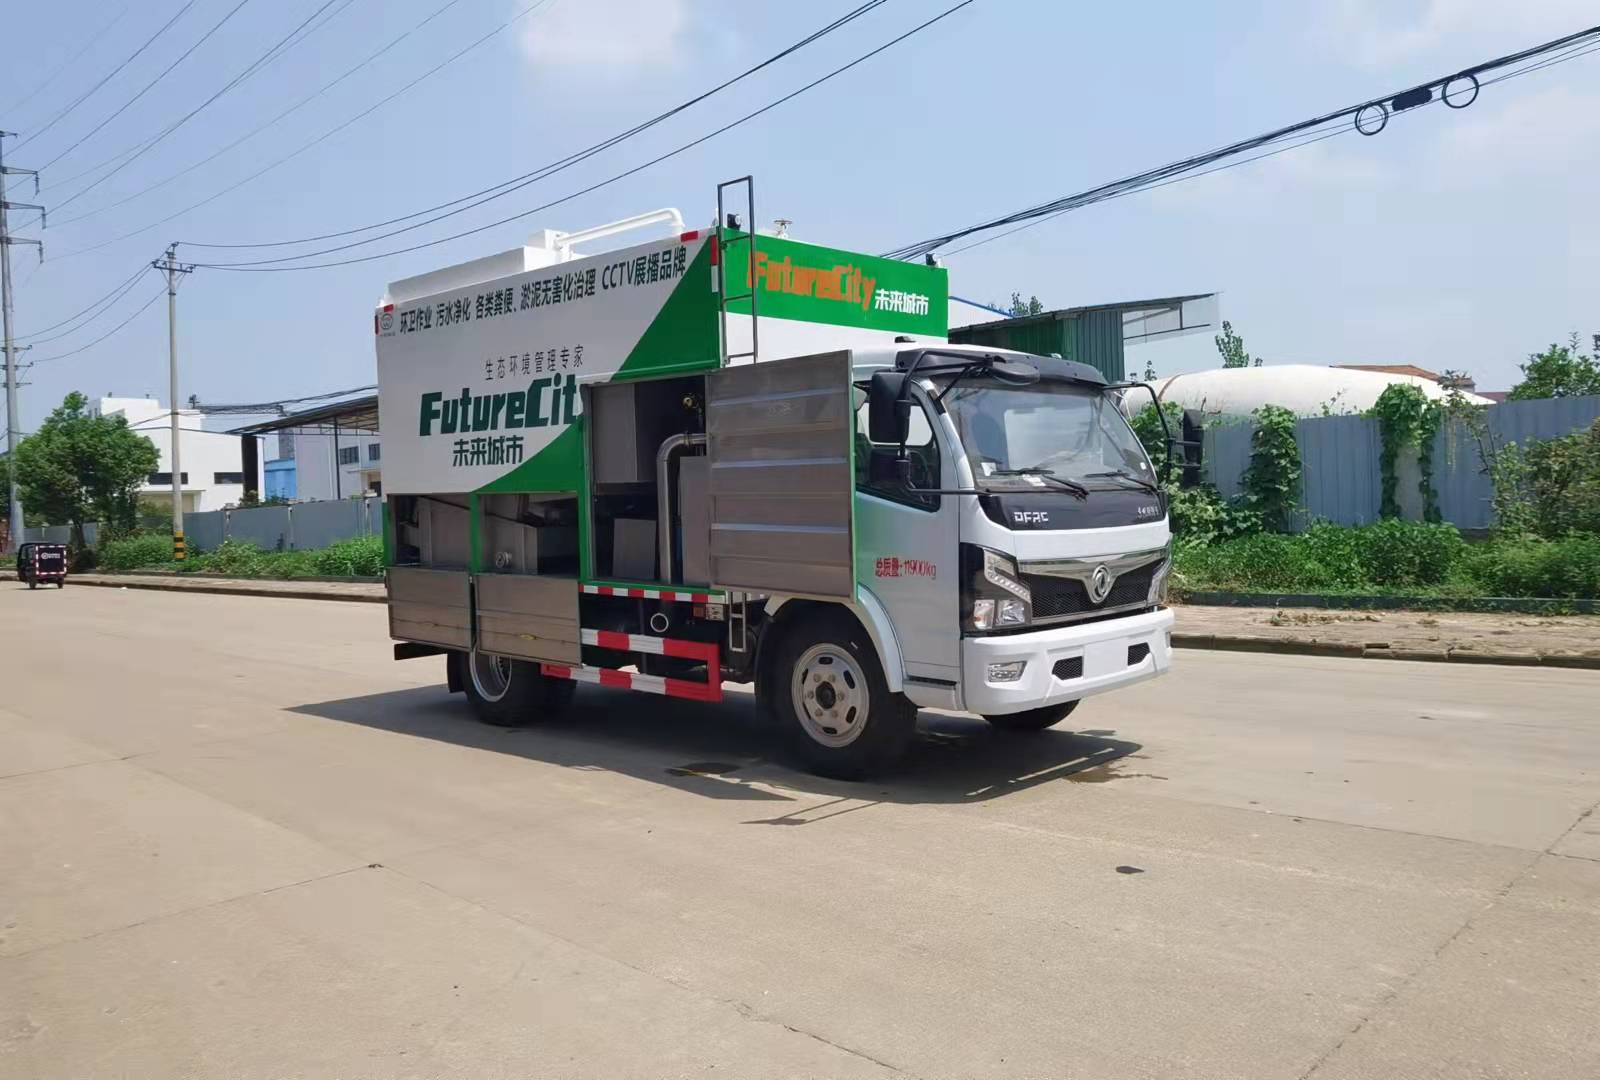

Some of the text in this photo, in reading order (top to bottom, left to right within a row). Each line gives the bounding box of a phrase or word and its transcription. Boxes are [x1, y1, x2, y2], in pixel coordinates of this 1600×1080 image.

[400, 304, 433, 334] 环卫作业
[435, 296, 471, 327] 污水净化
[601, 245, 687, 291] CCTV展播品牌
[746, 251, 929, 316] FutureCity 未来城市
[485, 344, 584, 381] 生态环境管理专家
[419, 372, 578, 437] FutureCit
[452, 434, 524, 467] 未来城市
